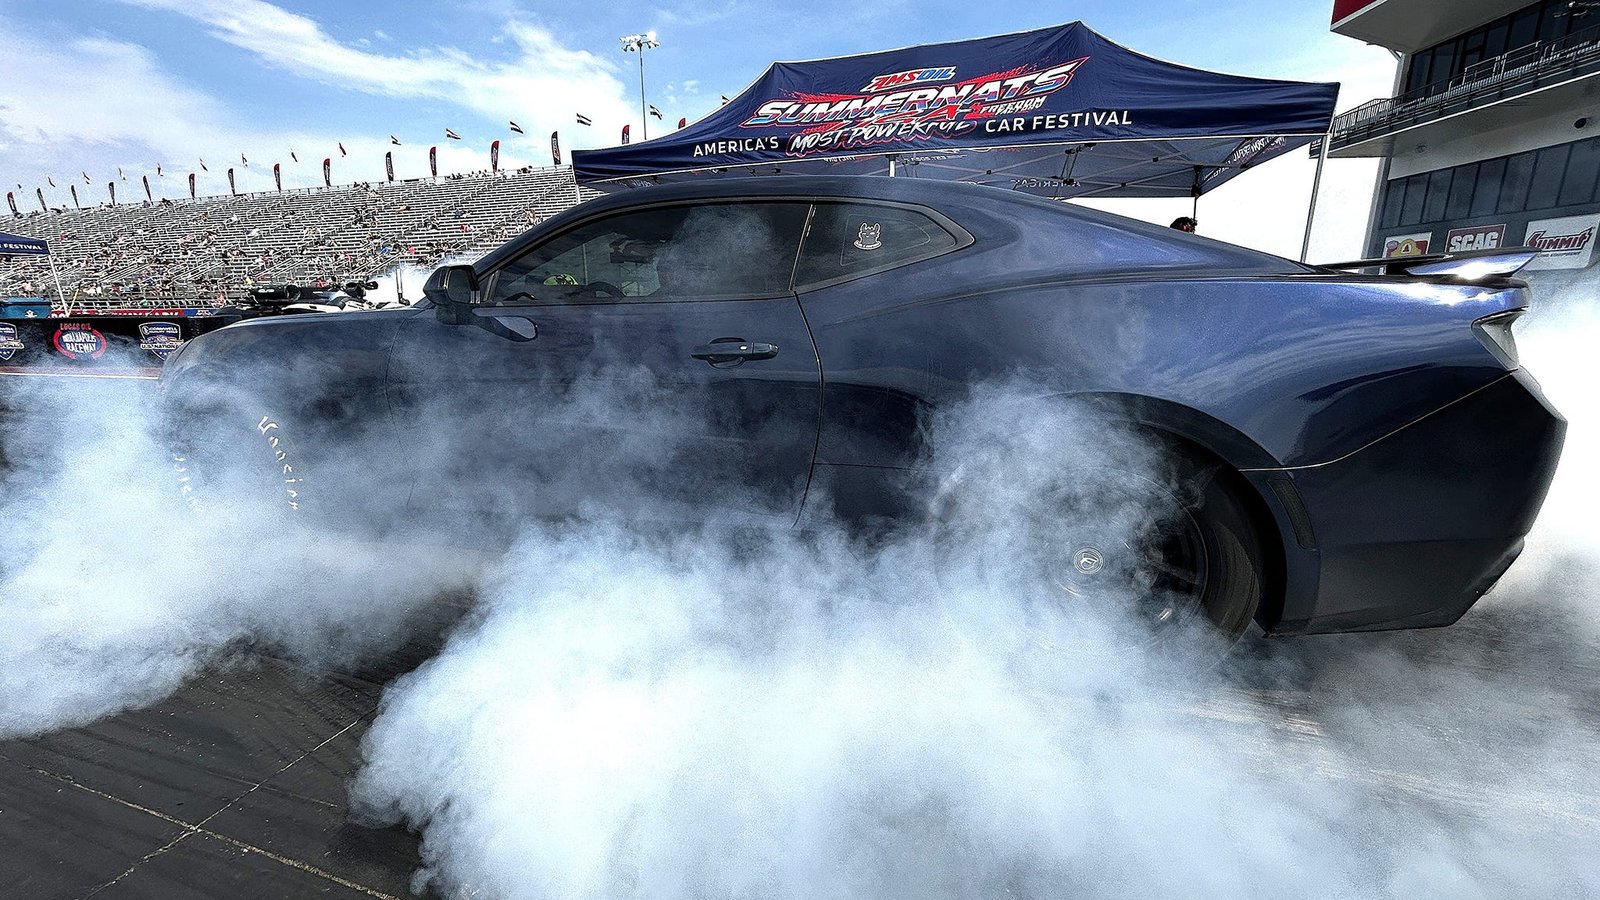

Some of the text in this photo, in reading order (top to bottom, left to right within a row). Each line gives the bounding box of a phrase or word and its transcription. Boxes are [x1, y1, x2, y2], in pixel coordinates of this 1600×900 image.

[865, 67, 954, 91] AMSOIL
[745, 59, 1084, 125] SUMMERNATS
[692, 135, 779, 158] AMERICA'S
[790, 128, 844, 152] MOST
[985, 118, 1025, 133] CAR
[1032, 110, 1132, 130] FESTIVAL
[1450, 232, 1497, 252] SCAG
[66, 342, 96, 353] RACEWAY
